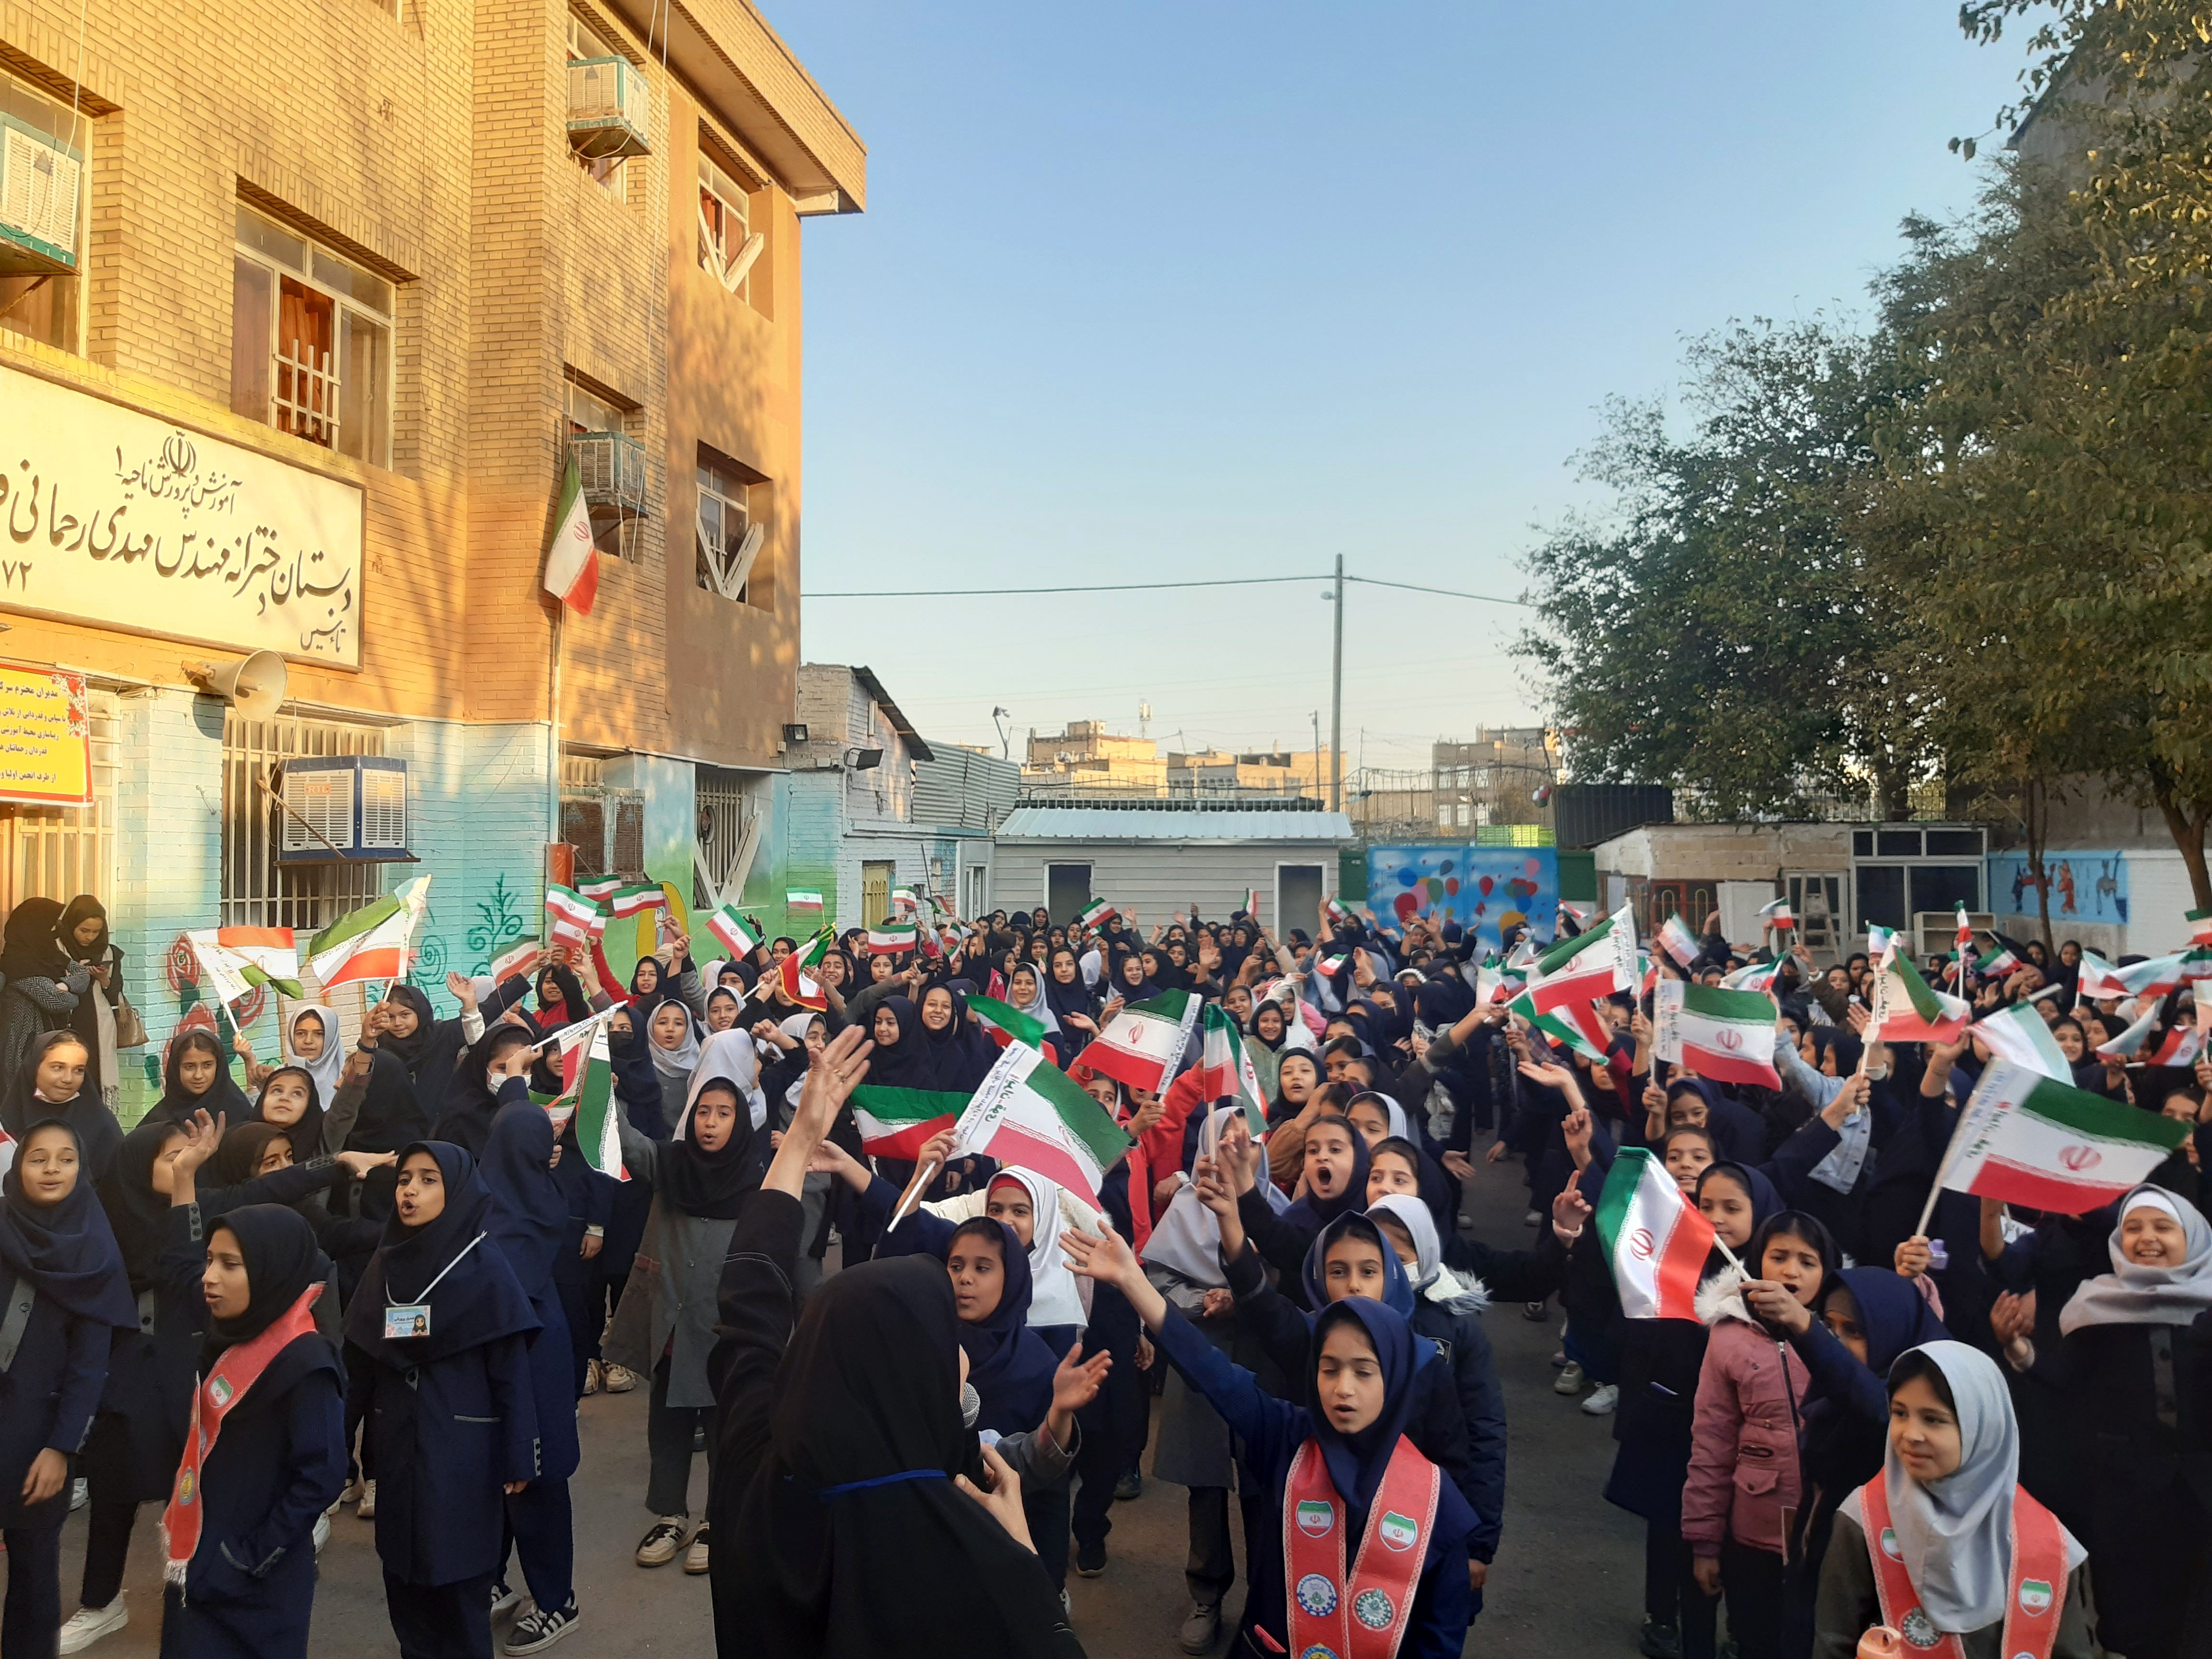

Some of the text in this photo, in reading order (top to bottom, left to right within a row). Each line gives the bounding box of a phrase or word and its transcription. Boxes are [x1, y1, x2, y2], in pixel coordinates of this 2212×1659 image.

[121, 458, 153, 500] ناحیه
[149, 456, 191, 519] پرورش
[191, 471, 242, 516] آموزش
[9, 458, 87, 552] رحمانی
[88, 505, 154, 564] مهدی
[155, 530, 230, 579] مهندس
[225, 525, 281, 616] دخترانه
[271, 550, 351, 617] دبستان
[15, 685, 34, 696] محترم
[36, 686, 58, 699] مدیران
[2, 707, 15, 717] تلاش
[16, 709, 21, 719] از
[1, 725, 22, 735] آموزشی
[23, 727, 36, 737] محیط
[29, 746, 47, 756] قدردان
[19, 770, 36, 781] انجمن
[37, 771, 49, 782] طرف
[51, 773, 56, 783] از
[308, 785, 326, 793] RTL
